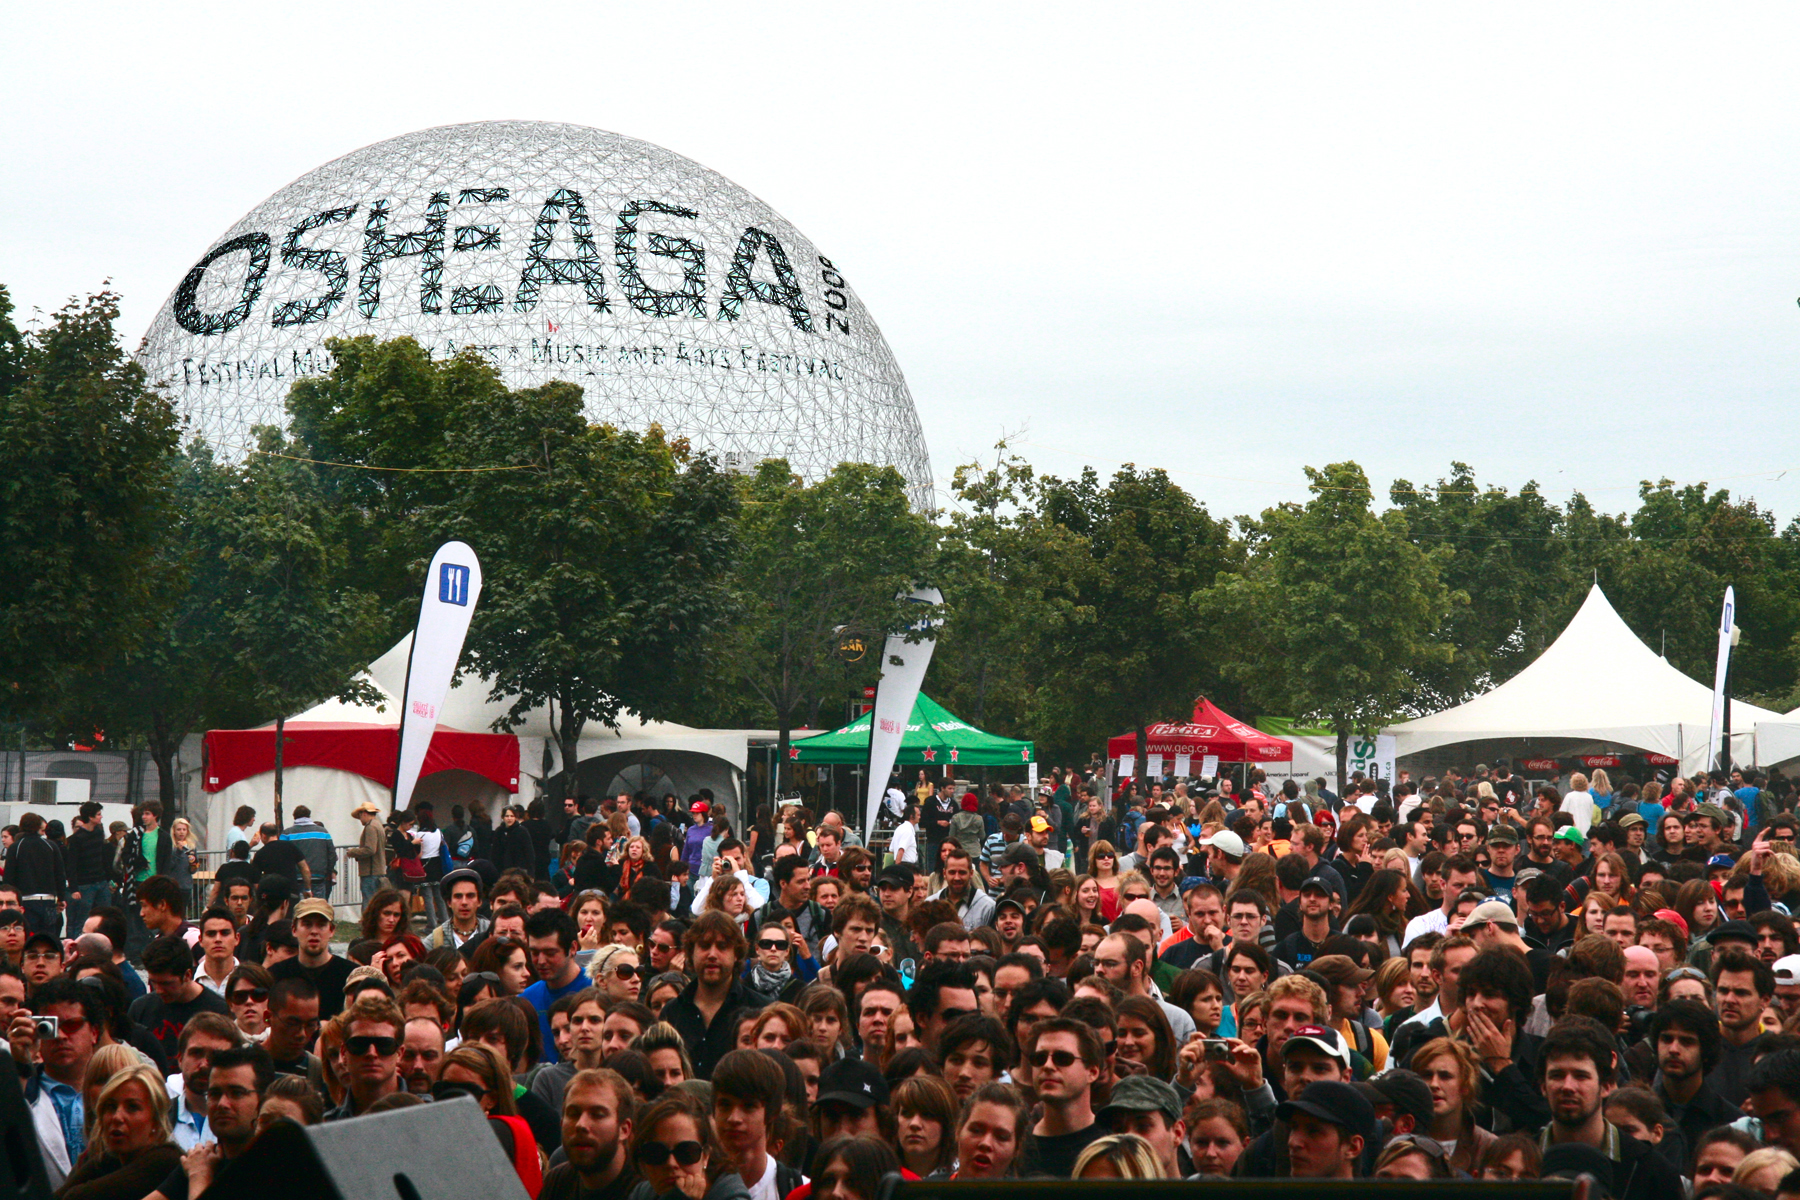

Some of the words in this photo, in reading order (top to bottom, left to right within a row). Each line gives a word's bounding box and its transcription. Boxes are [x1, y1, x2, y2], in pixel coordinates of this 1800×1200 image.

[174, 187, 815, 336] OSHEAGA
[849, 723, 921, 734] Heen
[1145, 744, 1209, 755] www.geg.ca
